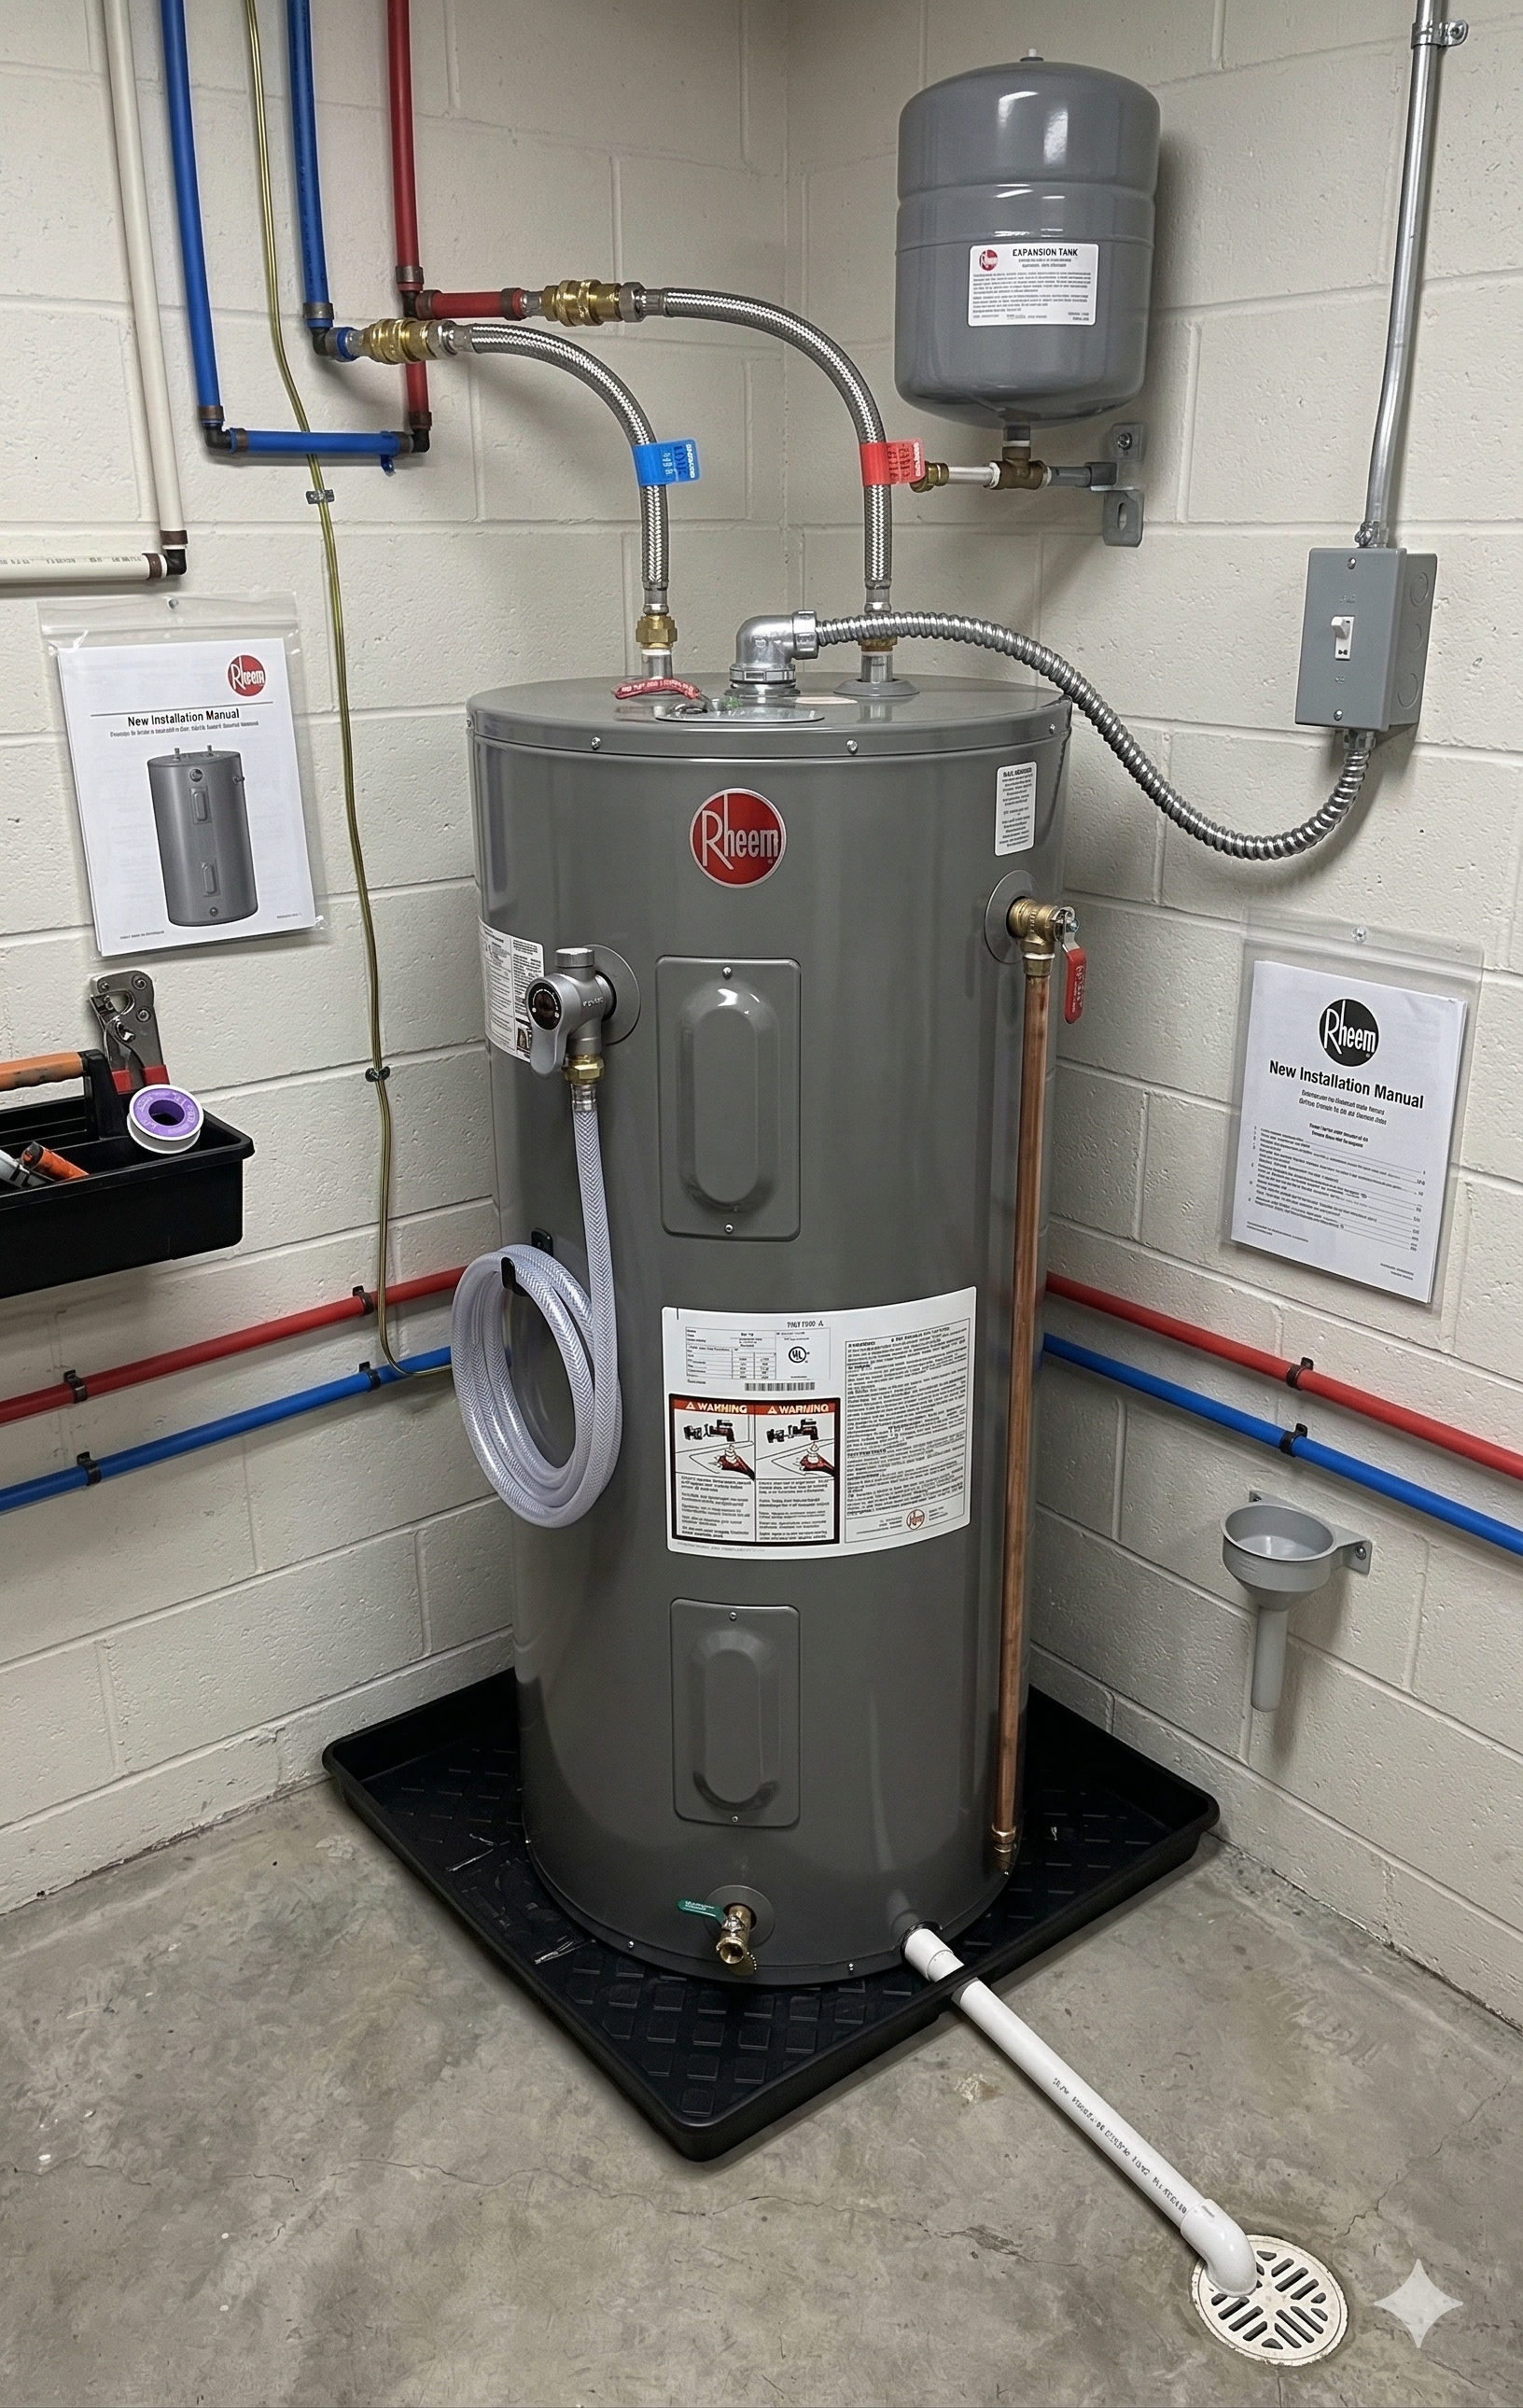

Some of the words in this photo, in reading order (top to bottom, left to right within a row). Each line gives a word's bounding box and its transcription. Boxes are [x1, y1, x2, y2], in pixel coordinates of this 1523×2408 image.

[1013, 248, 1056, 257] EXPANSION
[1059, 247, 1078, 256] TANK
[128, 716, 148, 727] New
[151, 711, 203, 725] Installation
[206, 708, 240, 721] Manual
[702, 792, 778, 870] Rheem
[1324, 1000, 1376, 1055] Rheem
[1269, 1059, 1296, 1078] New
[1299, 1067, 1370, 1096] Installation
[1374, 1084, 1424, 1109] Manual
